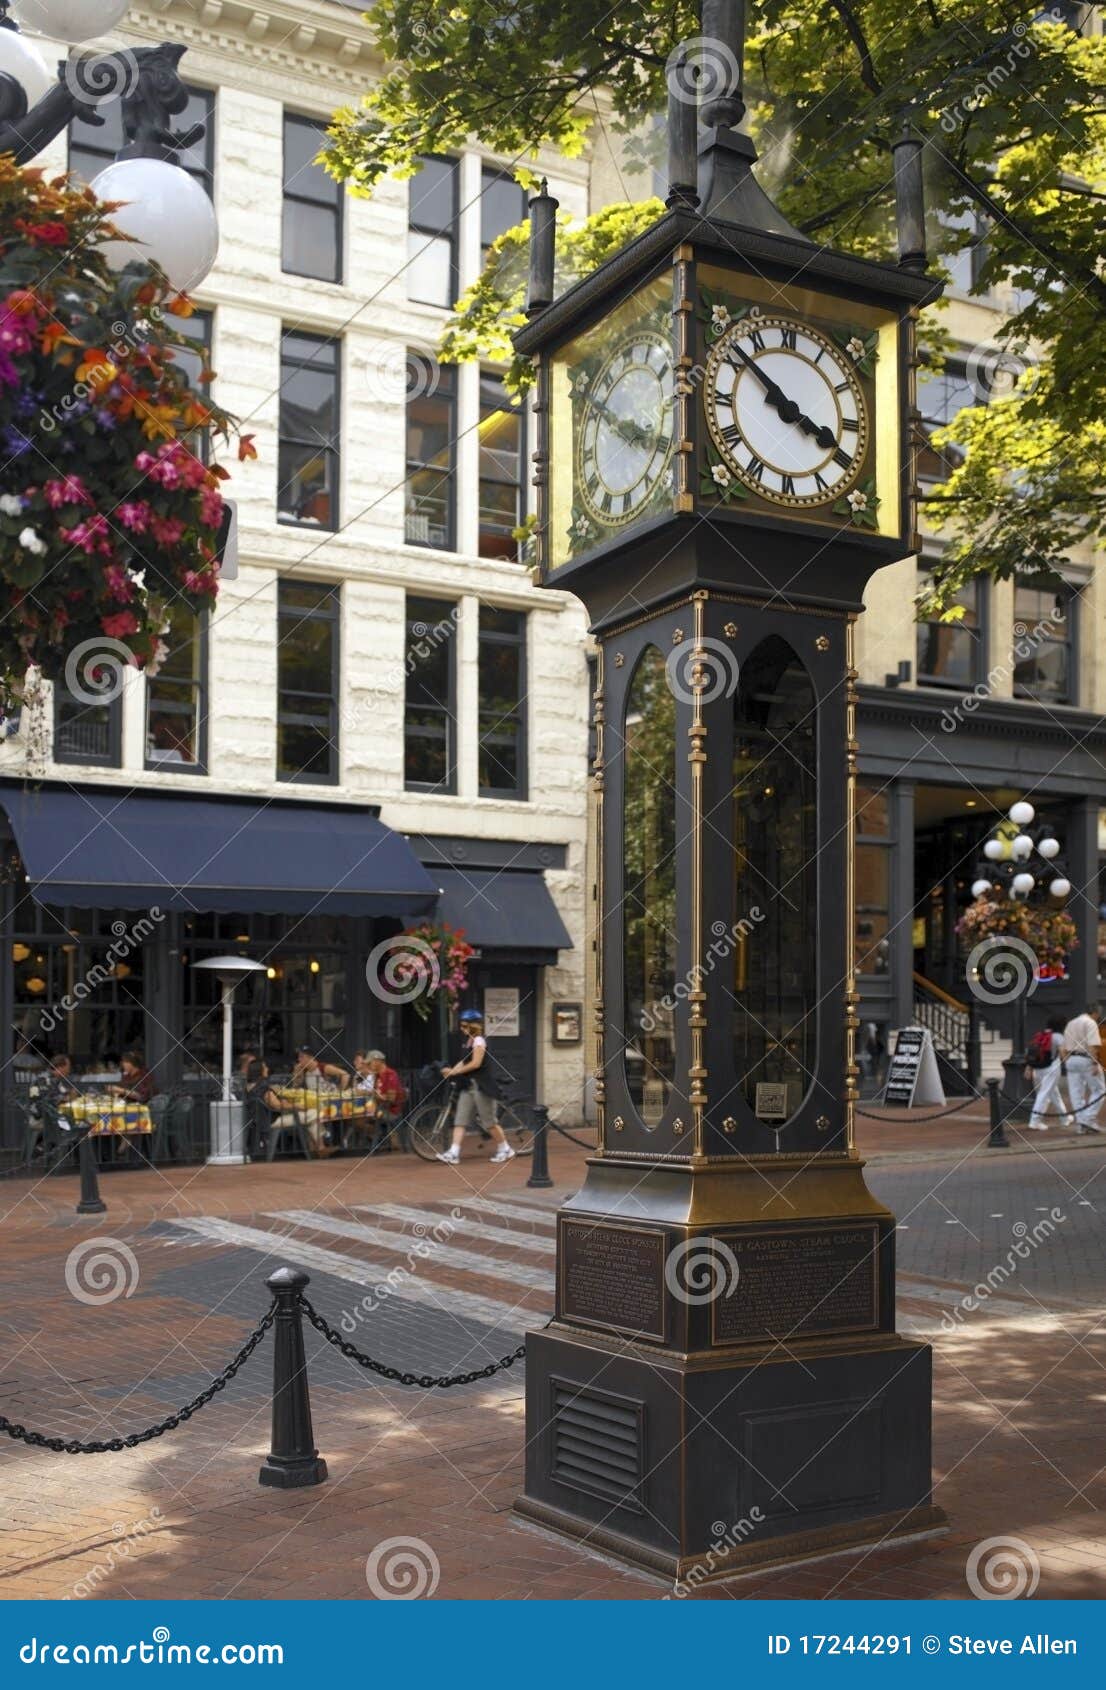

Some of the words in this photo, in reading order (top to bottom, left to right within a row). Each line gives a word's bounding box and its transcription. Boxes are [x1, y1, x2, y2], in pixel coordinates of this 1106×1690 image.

[781, 329, 797, 350] XII
[834, 382, 851, 394] II
[715, 390, 733, 407] IX
[842, 418, 860, 432] III
[782, 475, 796, 496] VI
[814, 472, 829, 492] V
